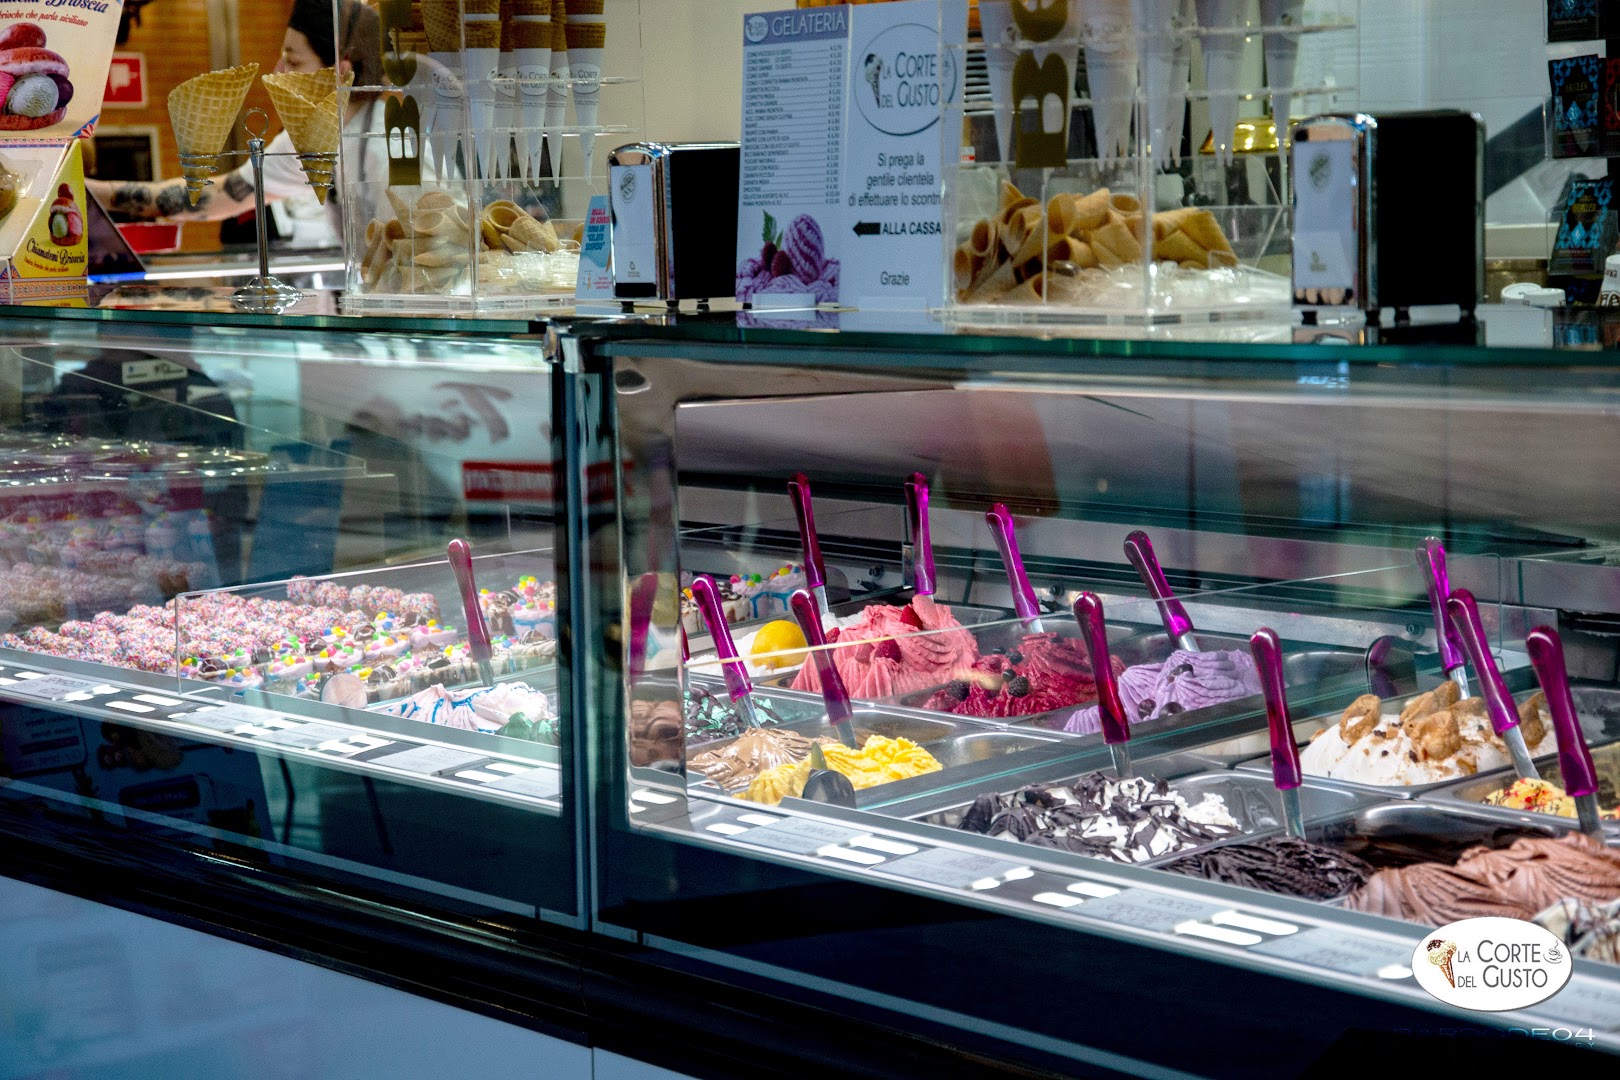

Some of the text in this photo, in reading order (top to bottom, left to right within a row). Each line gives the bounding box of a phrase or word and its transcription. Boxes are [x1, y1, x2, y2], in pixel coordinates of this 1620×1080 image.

[771, 10, 846, 36] GELATERIA
[883, 51, 937, 79] LA CORTE
[881, 80, 940, 108] DEL GUSTO
[877, 152, 925, 170] Si prega la
[866, 172, 935, 190] gentile clientela
[848, 193, 857, 207] di
[858, 192, 899, 206] effettuare
[901, 193, 909, 206] lo
[882, 221, 942, 235] ALLA CASSA
[880, 271, 910, 286] Grazie
